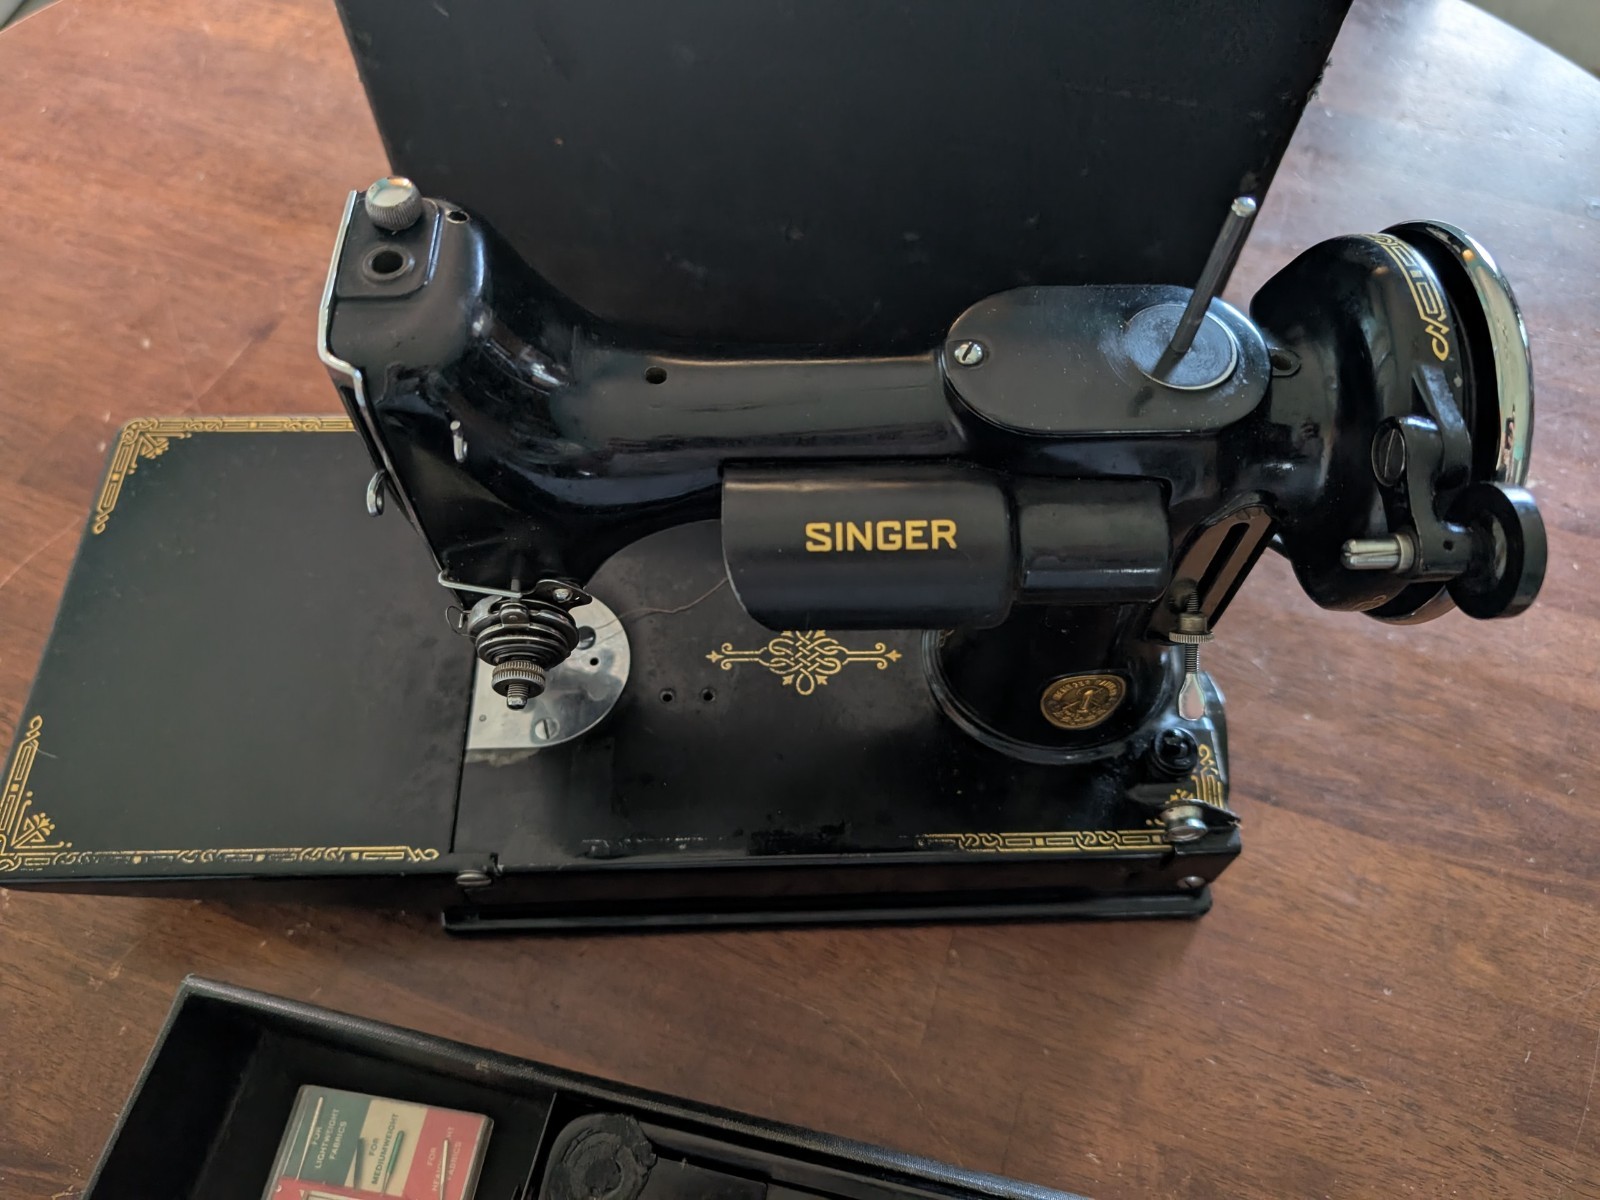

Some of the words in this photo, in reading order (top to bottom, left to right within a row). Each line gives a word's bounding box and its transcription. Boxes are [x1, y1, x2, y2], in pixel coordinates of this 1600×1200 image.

[805, 519, 957, 552] SINGER
[315, 1108, 340, 1168] LIGHTWEIGHT
[329, 1120, 347, 1160] FABRICS
[368, 1137, 379, 1156] FOR
[371, 1112, 399, 1185] MEDIUMWEIGHT
[427, 1146, 437, 1167] FOR
